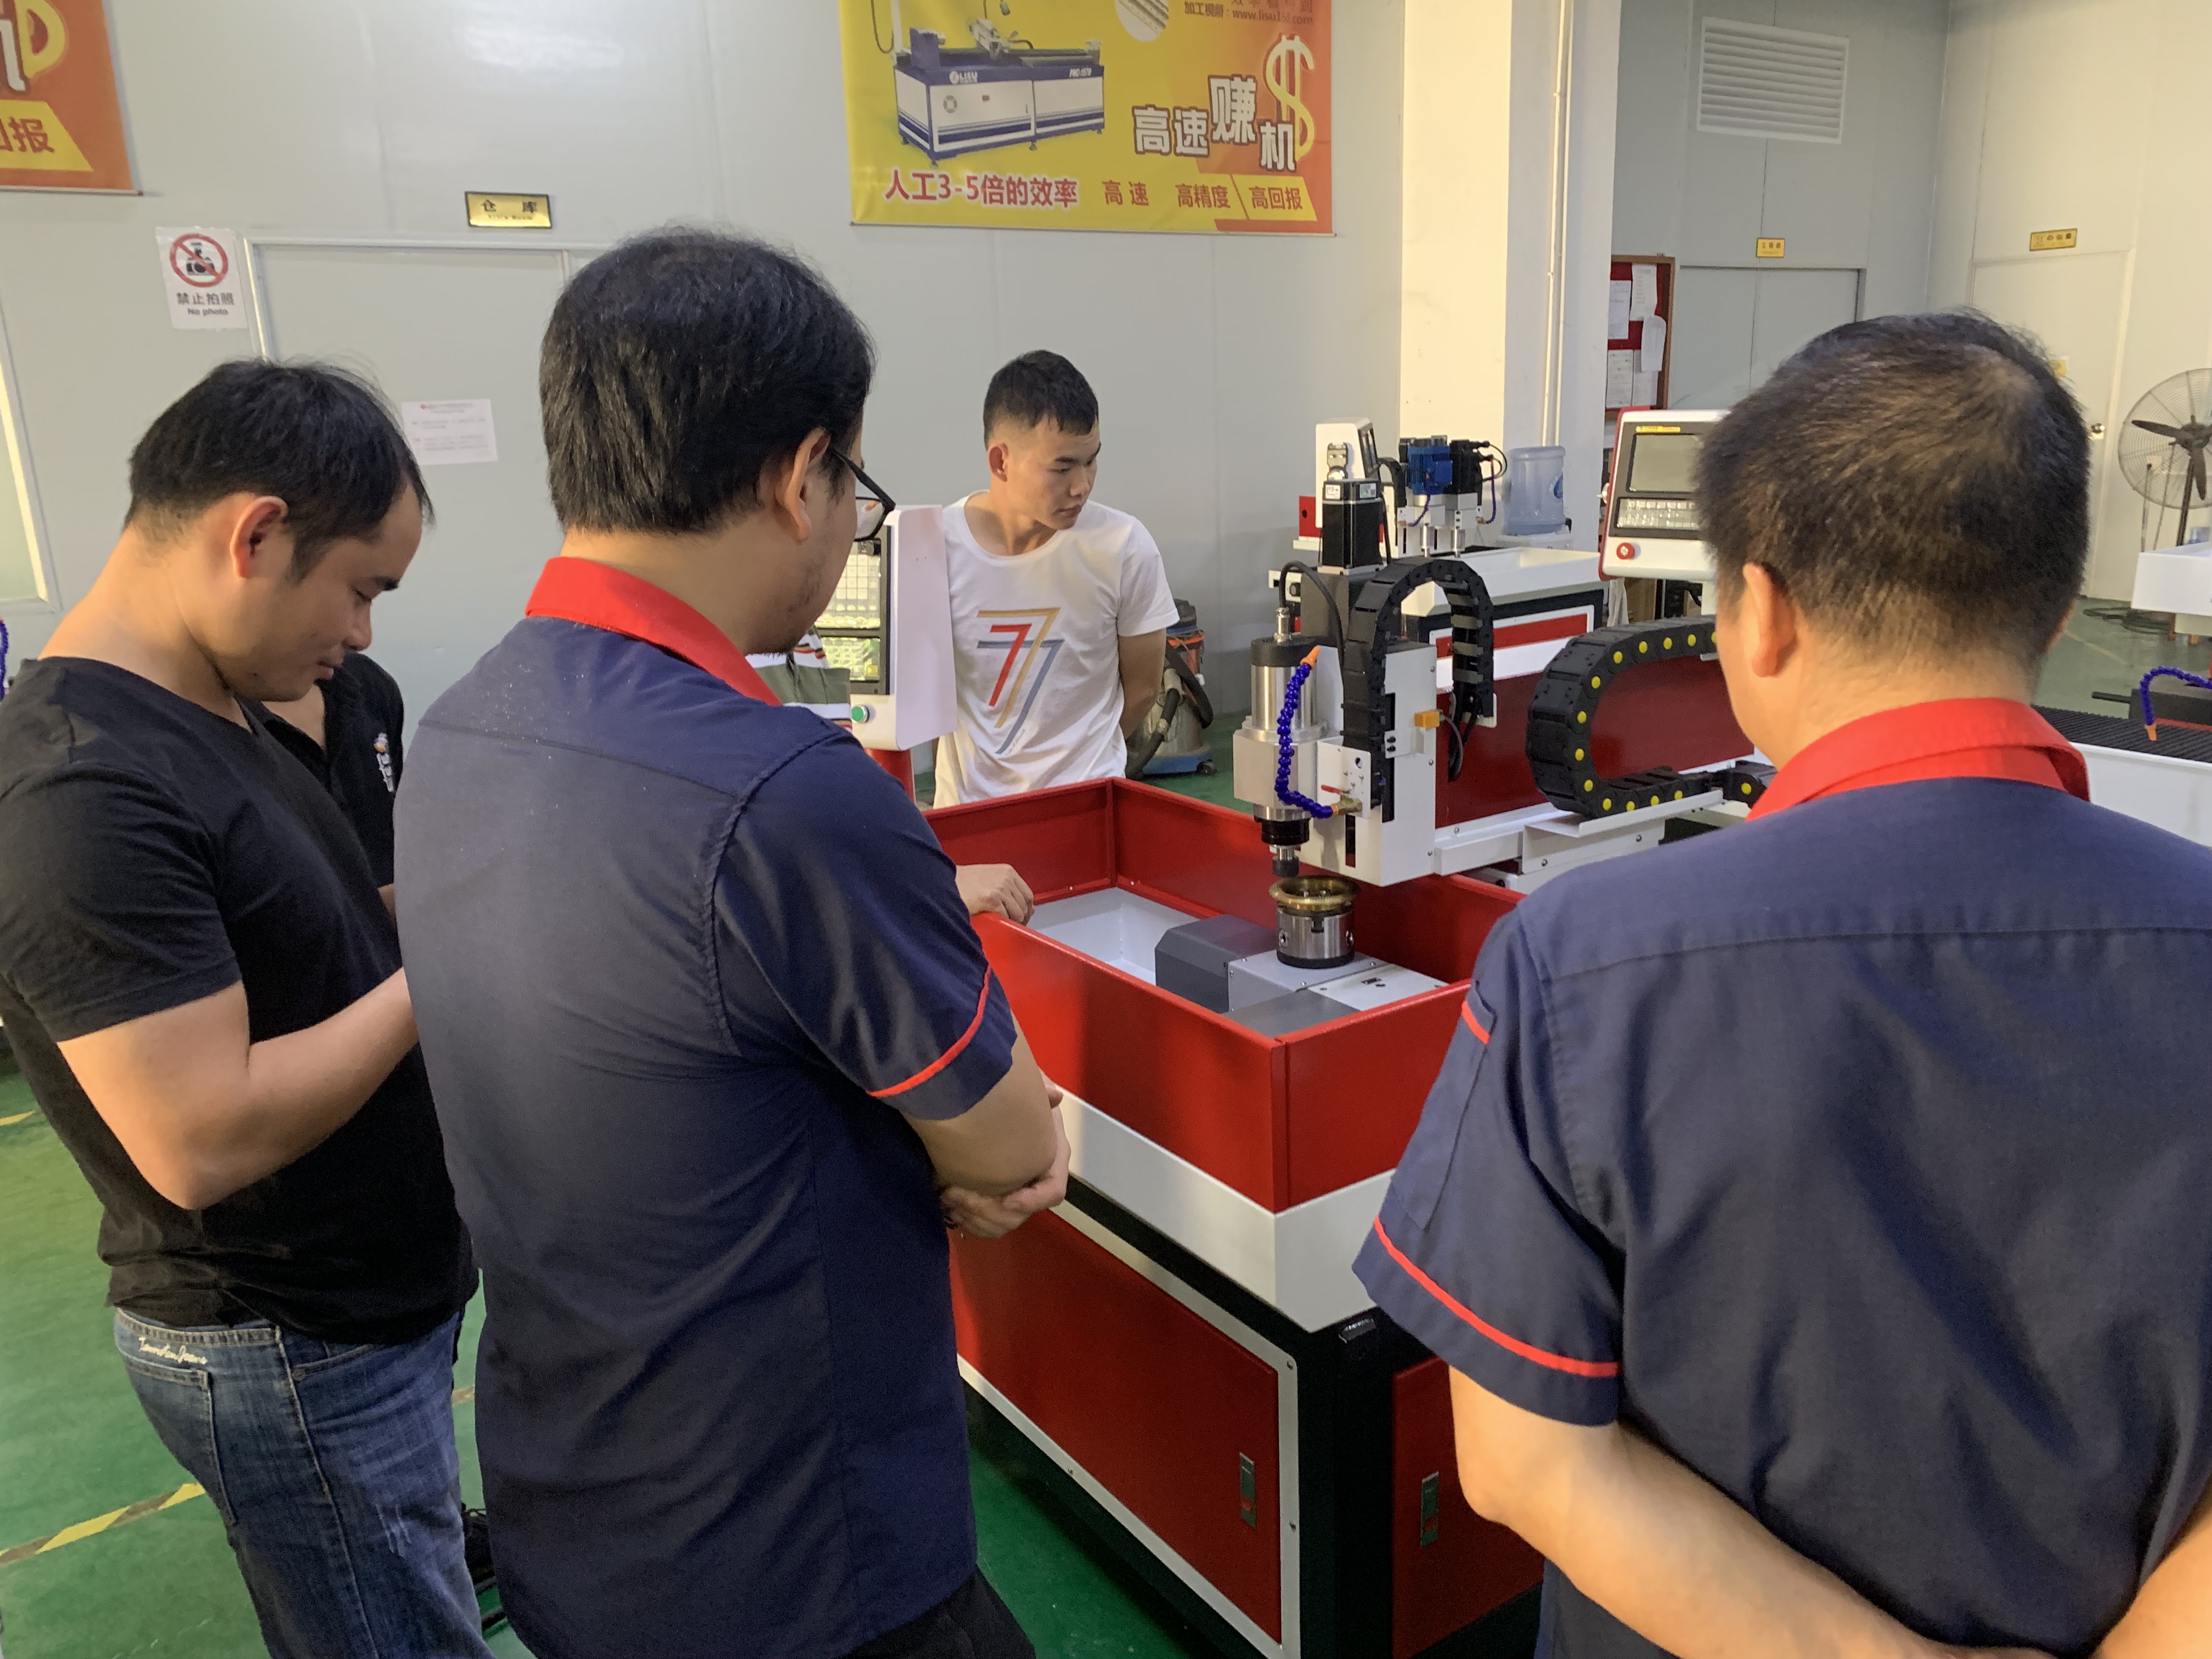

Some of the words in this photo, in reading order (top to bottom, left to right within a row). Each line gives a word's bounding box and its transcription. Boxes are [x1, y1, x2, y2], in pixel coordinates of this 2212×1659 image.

[884, 169, 1077, 208] 人工3-5倍的效率
[1175, 183, 1231, 209] 高精度
[1248, 185, 1303, 210] 高回报
[202, 308, 229, 316] photo
